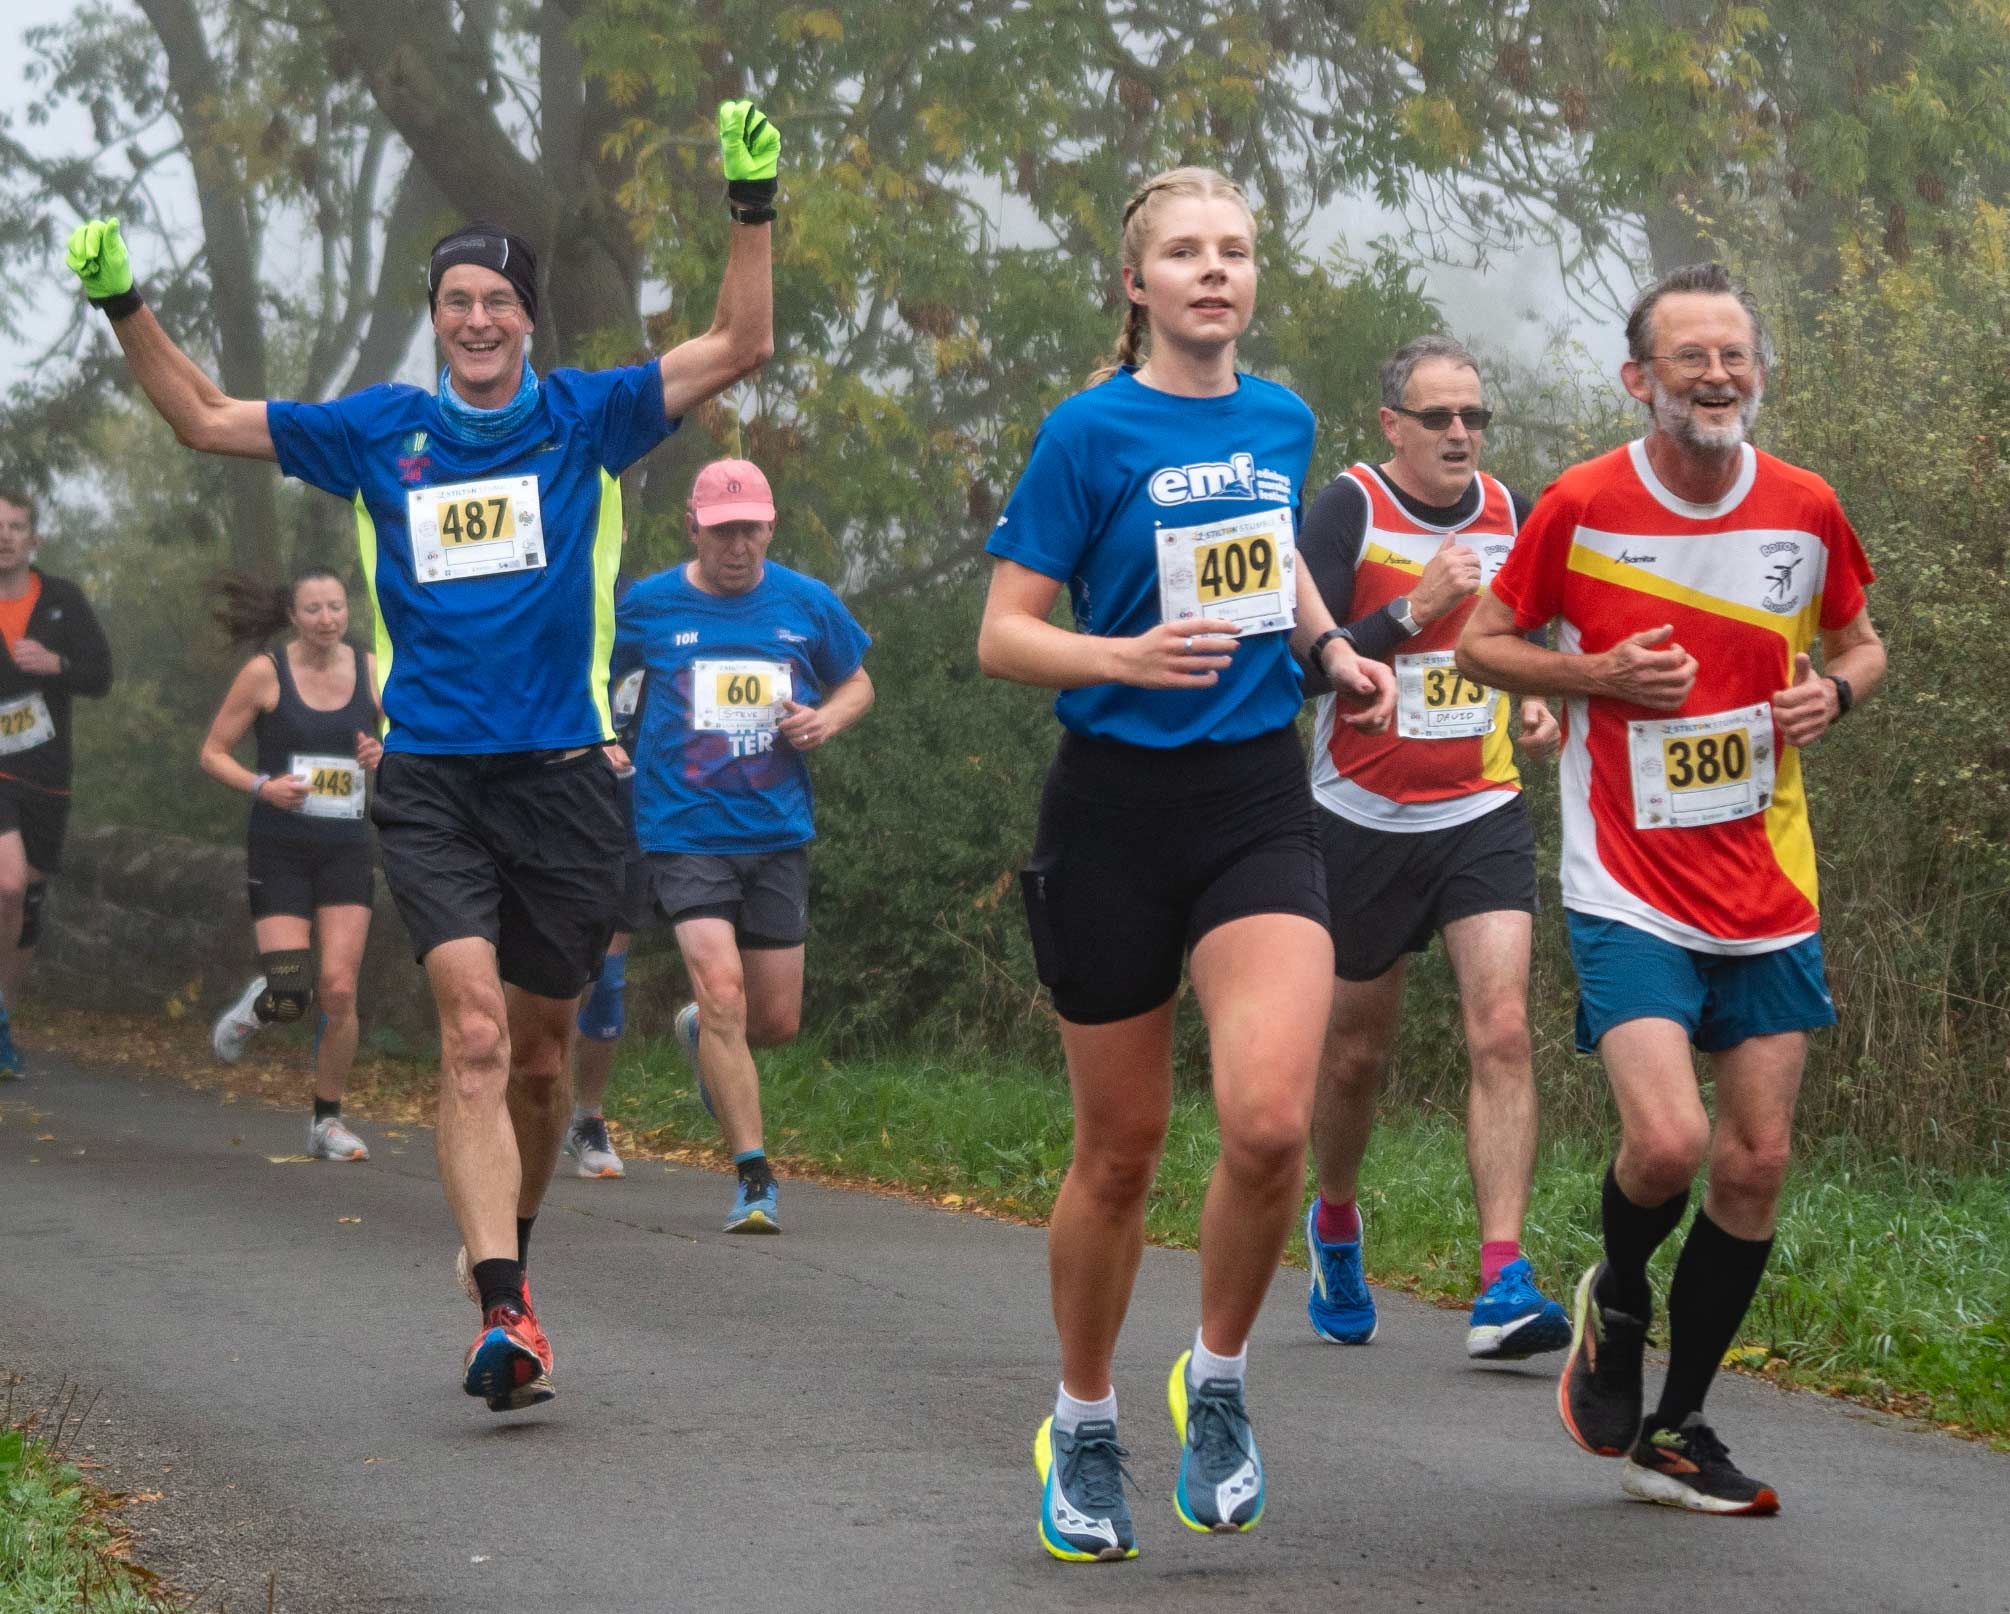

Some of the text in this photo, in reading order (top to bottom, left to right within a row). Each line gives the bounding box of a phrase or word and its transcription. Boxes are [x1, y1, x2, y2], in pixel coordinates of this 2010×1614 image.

[1149, 453, 1256, 506] emf
[442, 497, 509, 543] 487
[1200, 538, 1273, 597] 409
[675, 631, 699, 646] 10K
[727, 675, 761, 705] 60
[728, 731, 774, 758] TER
[1668, 733, 1745, 788] 380
[312, 770, 353, 797] 443
